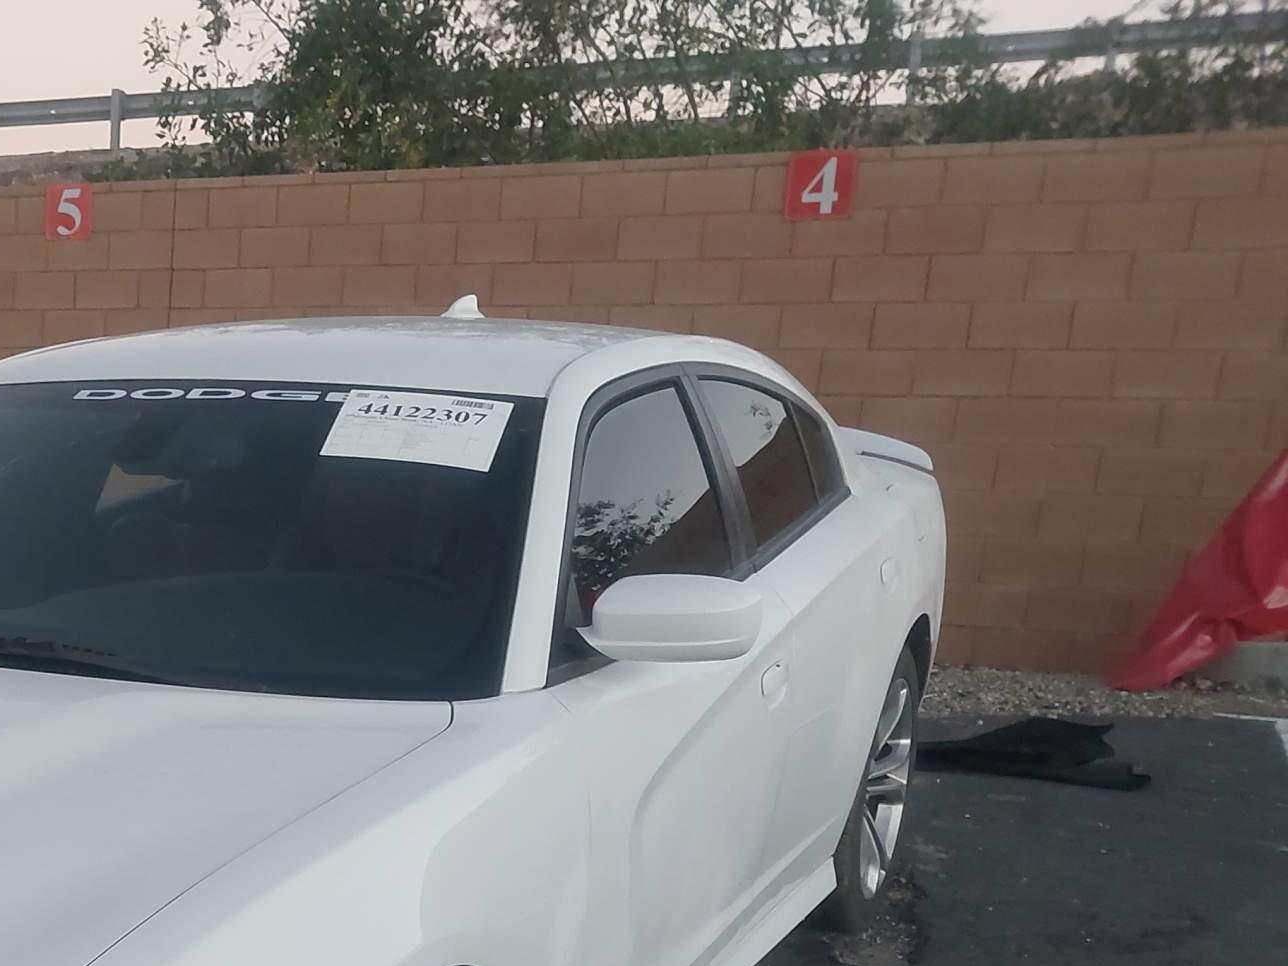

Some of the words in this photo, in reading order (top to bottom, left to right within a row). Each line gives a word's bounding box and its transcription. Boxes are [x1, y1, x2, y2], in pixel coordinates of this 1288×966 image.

[801, 156, 838, 214] 4
[57, 188, 82, 236] 5
[357, 402, 489, 426] 44122307
